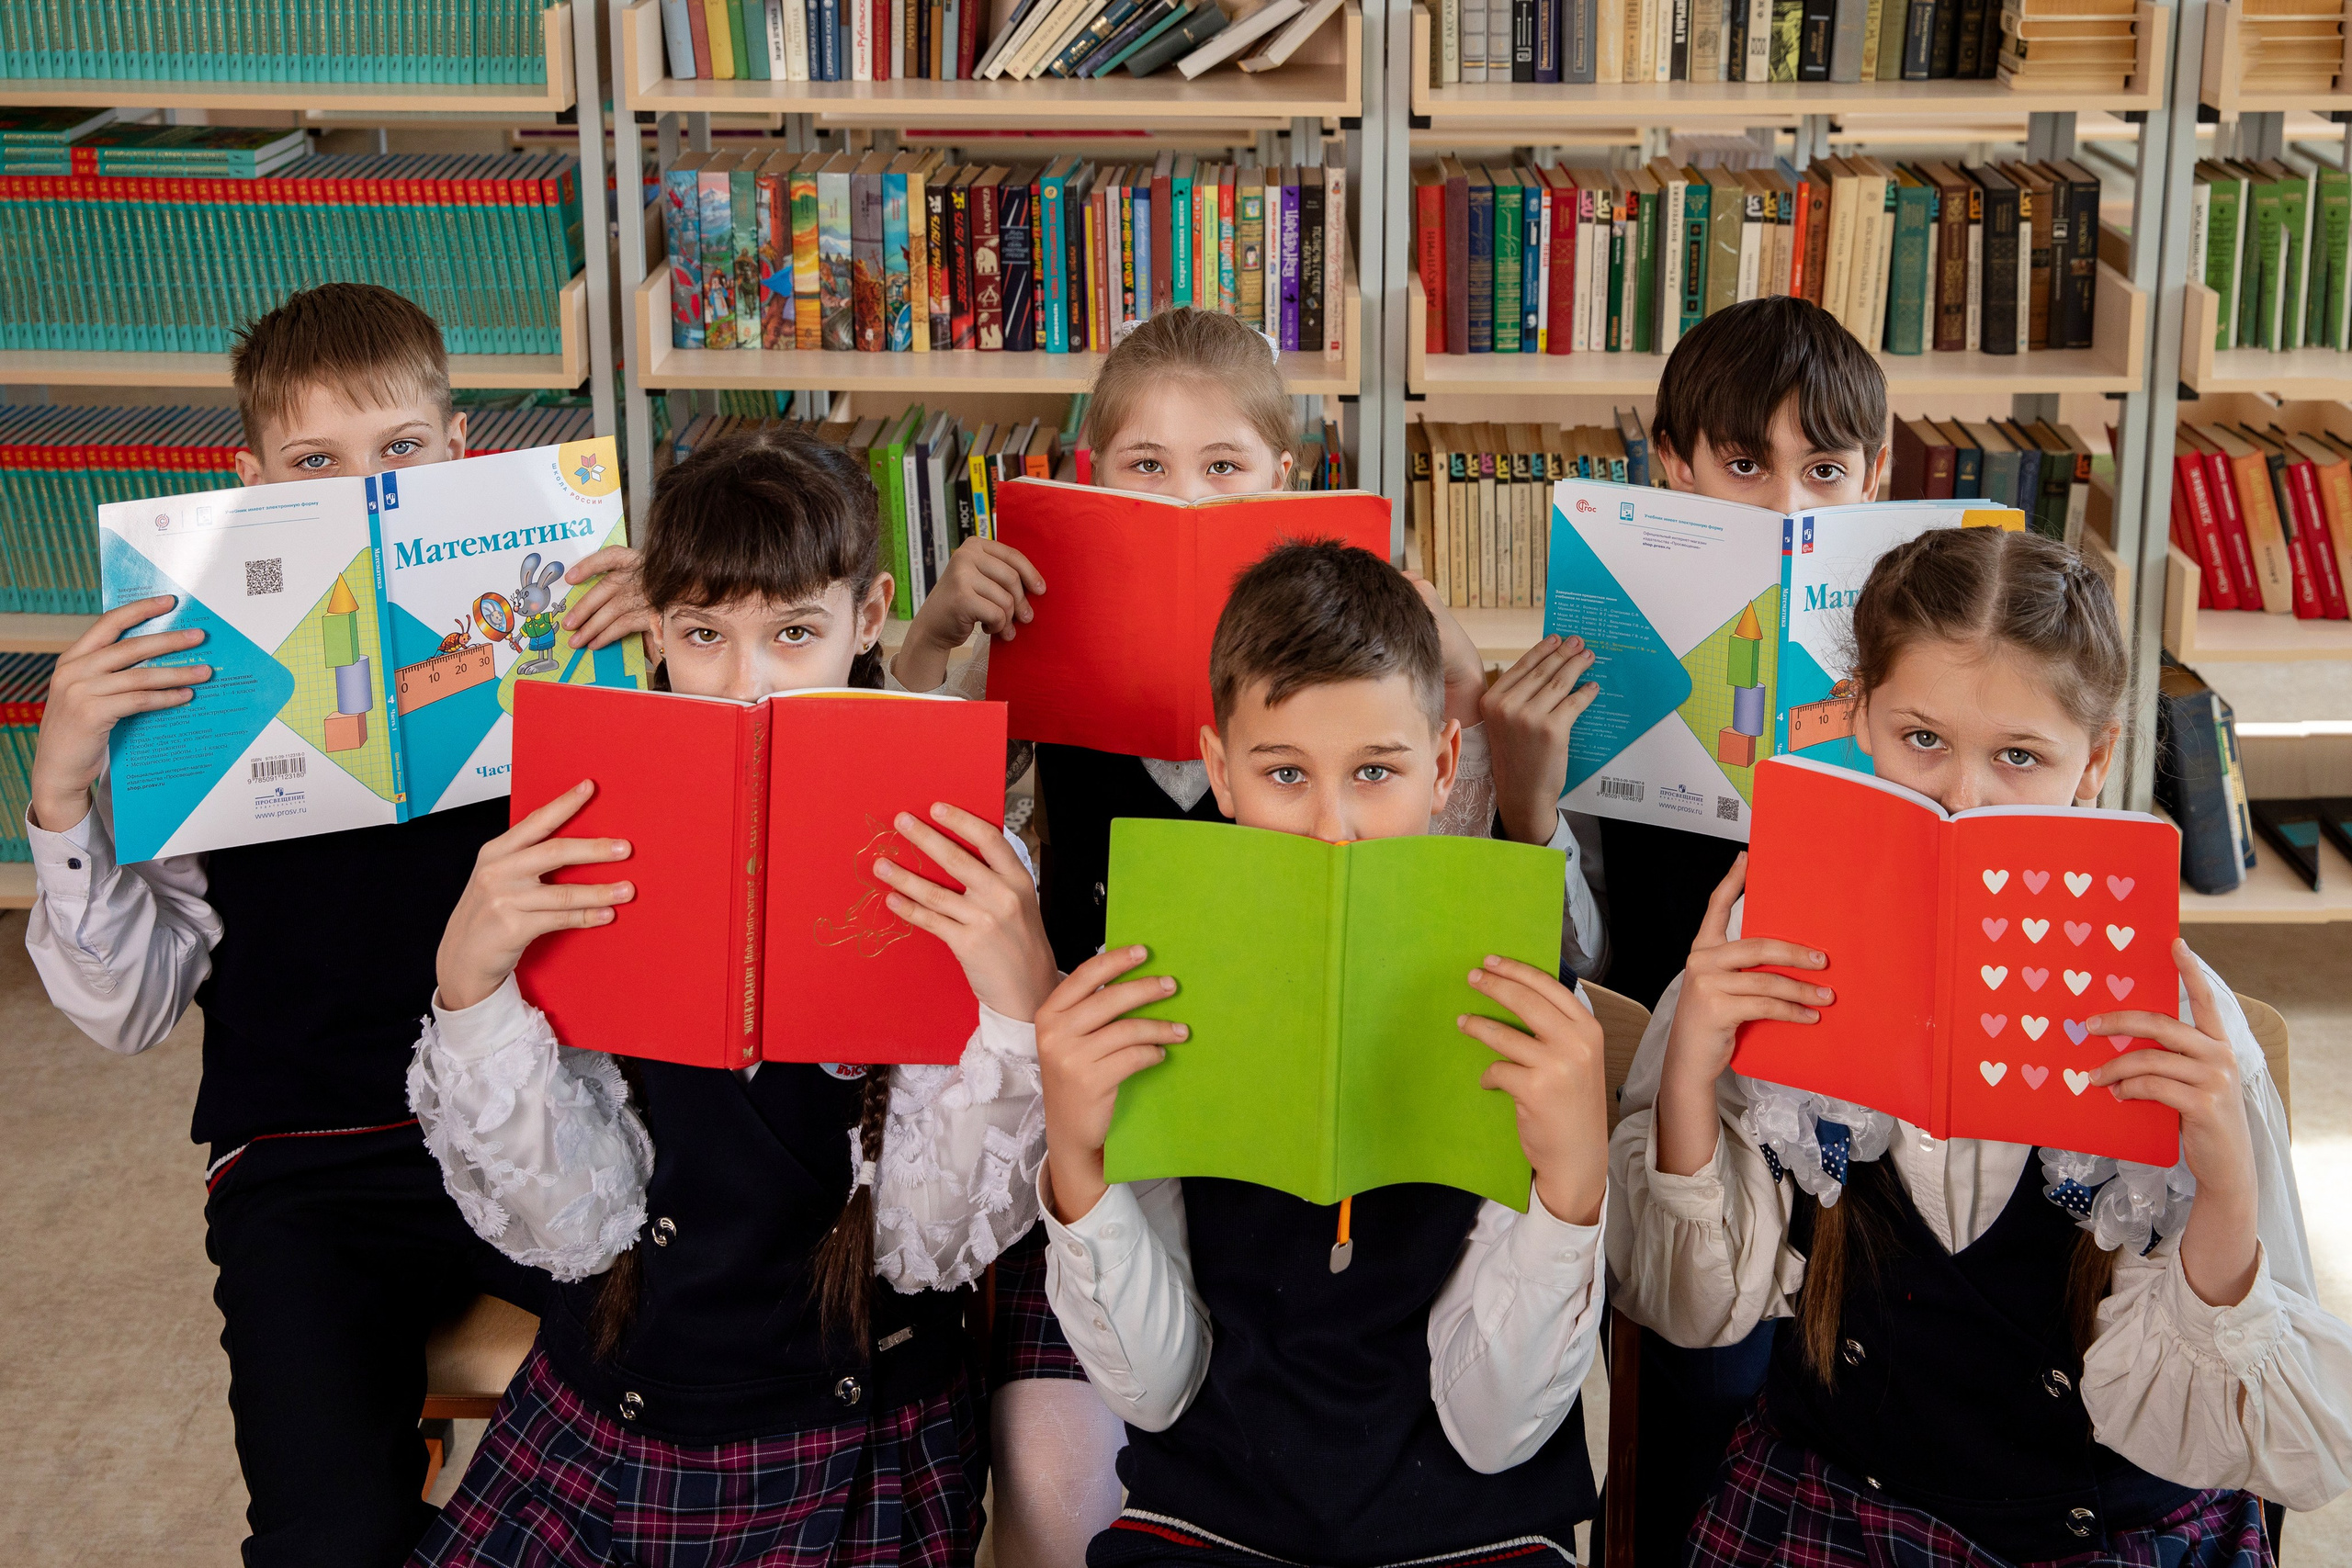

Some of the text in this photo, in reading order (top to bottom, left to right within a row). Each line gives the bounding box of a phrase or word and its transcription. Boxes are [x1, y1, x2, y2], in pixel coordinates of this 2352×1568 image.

[1178, 261, 1186, 288] Секрет
[551, 463, 603, 505] ШКОЛА РОССИИ
[960, 499, 971, 528] МОСТ
[1708, 524, 1724, 532] форму
[1643, 531, 1671, 541] Официальный
[393, 515, 595, 570] Математика
[374, 547, 383, 590] Математика
[1804, 583, 1859, 612] Мат
[1781, 588, 1790, 628] Математика
[220, 673, 254, 682] математике
[401, 656, 492, 694] 0 10 20 30
[388, 694, 395, 705] 4
[1777, 713, 1784, 721] 4
[1795, 711, 1855, 731] 0 10 20
[169, 719, 190, 728] работы
[126, 770, 164, 780] Официальный
[476, 762, 513, 779] Част
[127, 776, 164, 785] издательства
[254, 775, 278, 784] 785091
[281, 773, 305, 781] 123180
[127, 782, 166, 792] shop.prosv.ru
[255, 795, 306, 807] ПРОСВЕЩЕНИЕ
[1660, 790, 1704, 803] ПРОСВЕЩЕНИЕ
[255, 807, 307, 819] www.prosv.ru
[1659, 802, 1702, 816] www.prosv.ru
